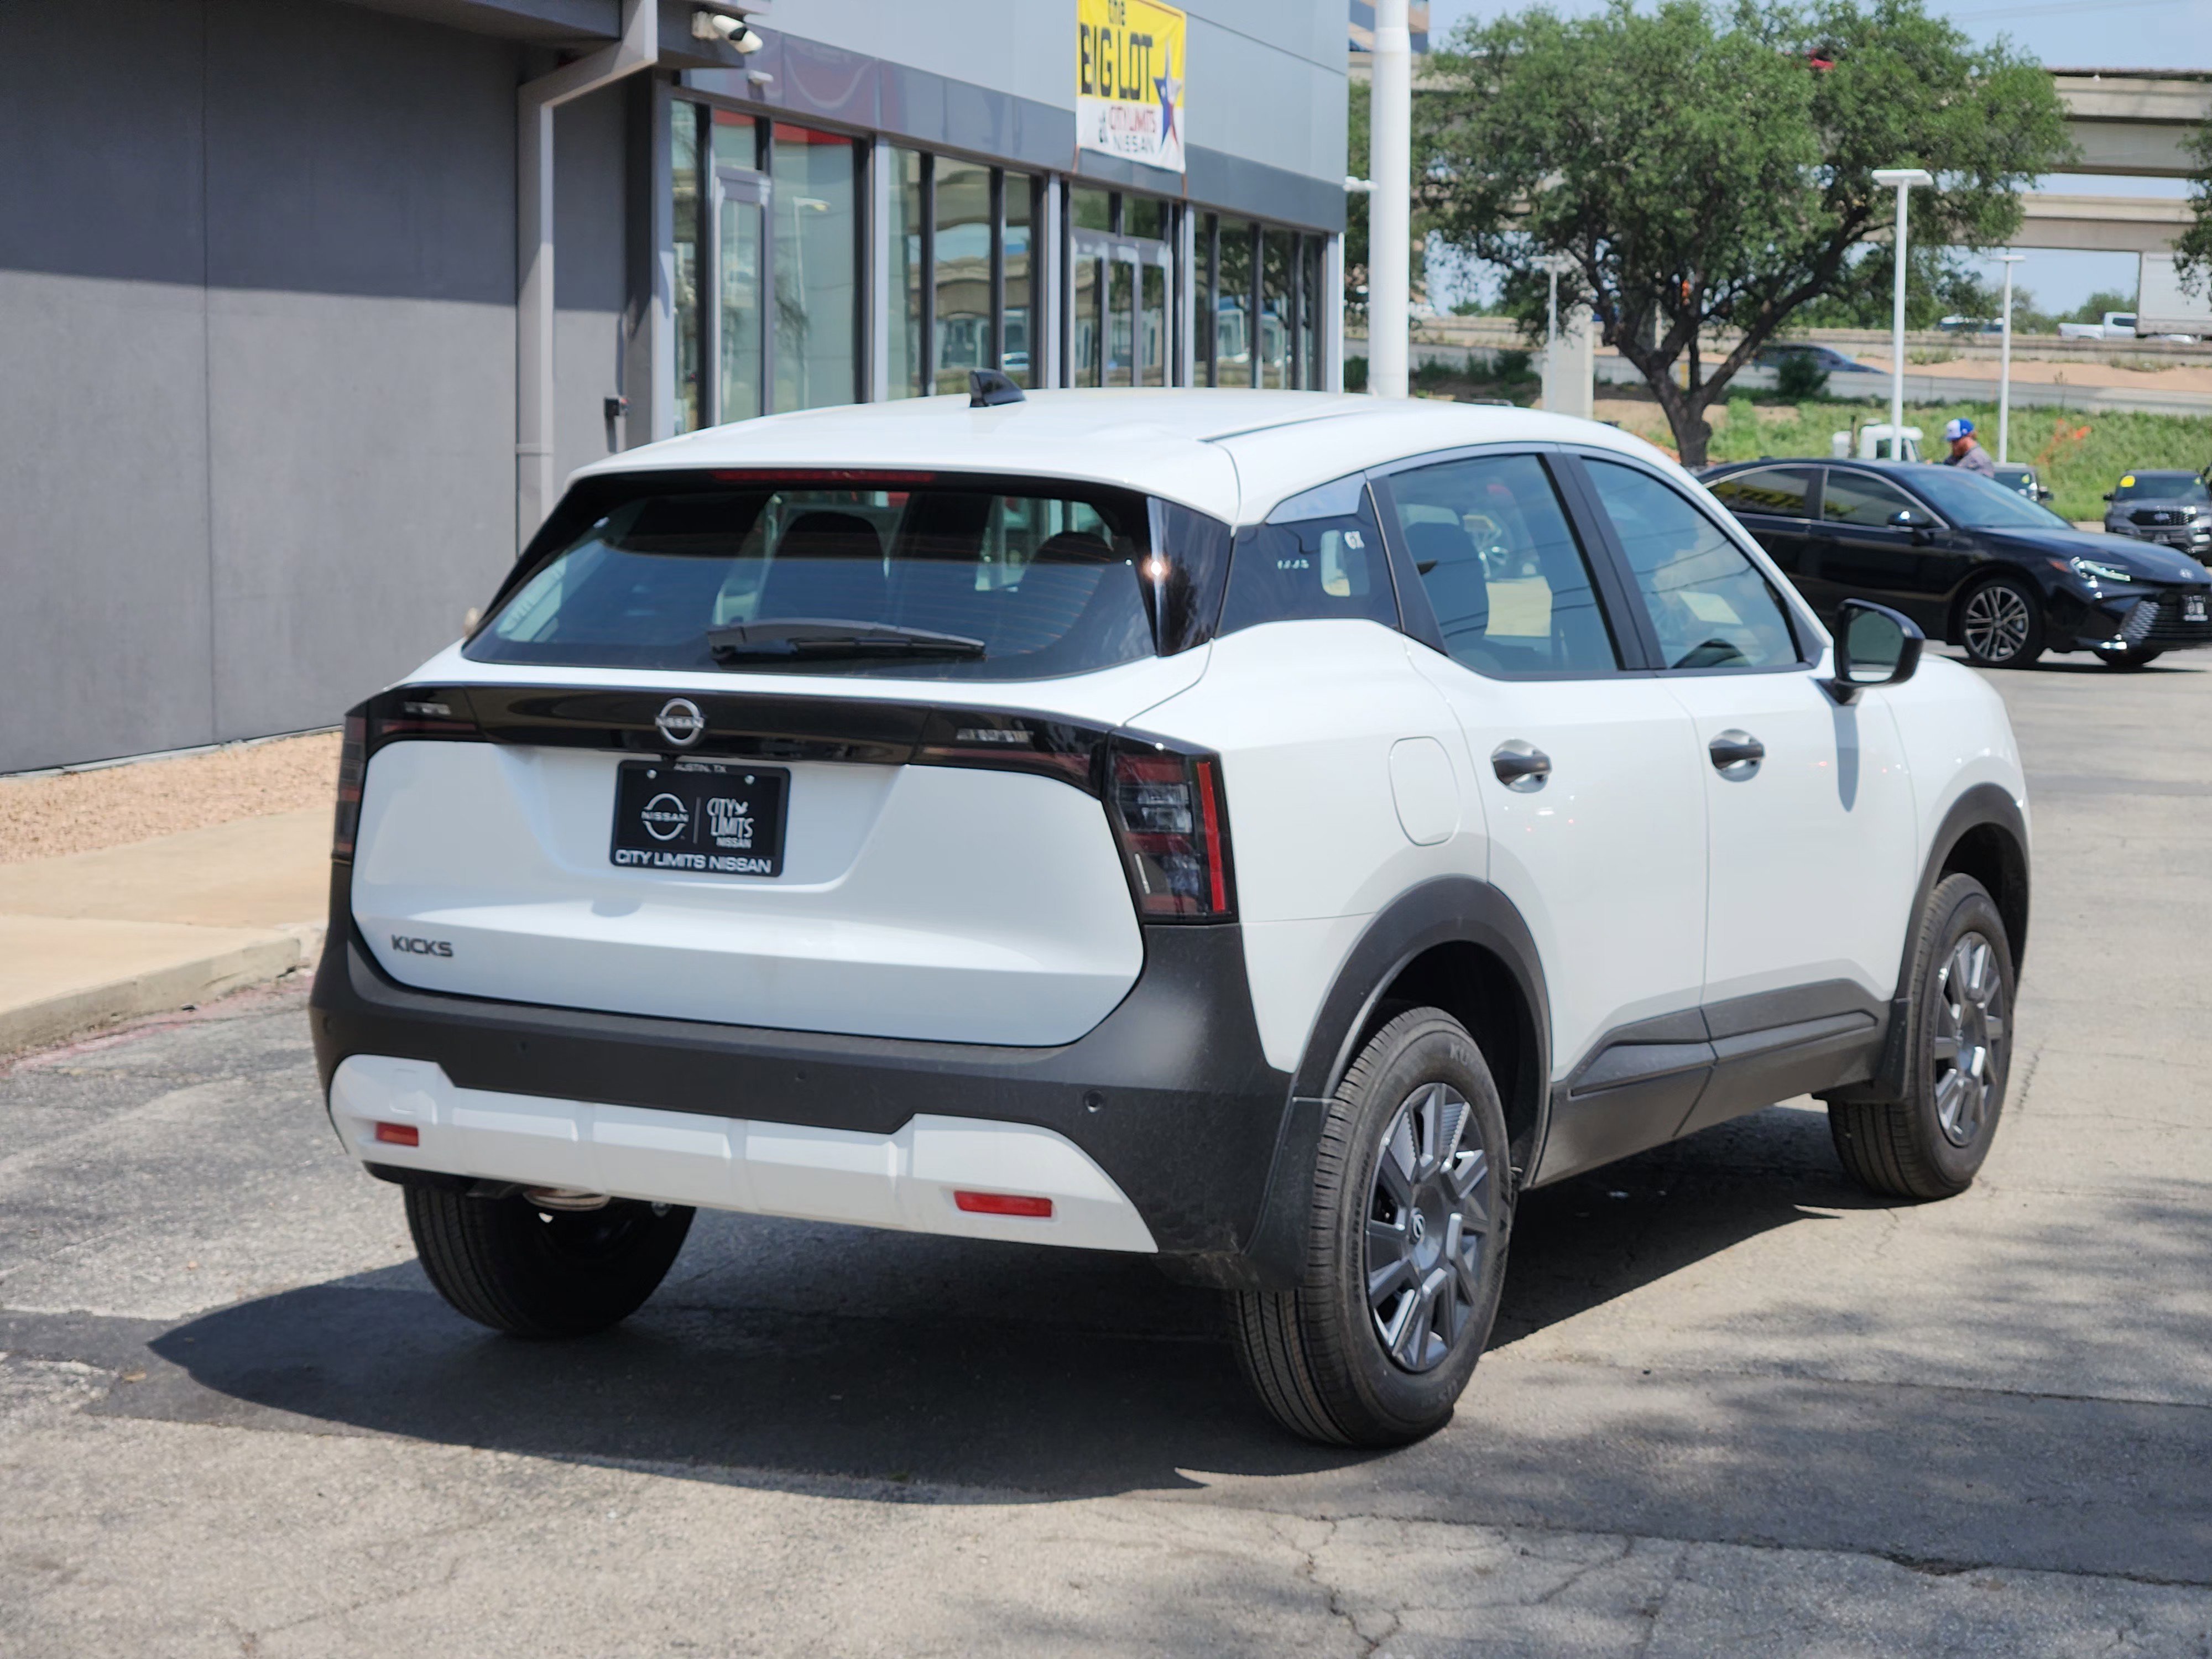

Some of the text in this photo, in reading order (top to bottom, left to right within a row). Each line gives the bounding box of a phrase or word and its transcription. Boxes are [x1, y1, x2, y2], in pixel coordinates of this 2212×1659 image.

[1081, 22, 1152, 102] BIG LOT
[1113, 134, 1155, 154] NISSAN
[655, 716, 704, 728] NISSAN
[641, 810, 690, 823] NISSAN
[707, 797, 737, 817] CITY
[711, 817, 754, 838] LIMITS
[716, 837, 752, 848] NISSAN
[615, 849, 772, 874] CITY LIMITS NISSAN
[391, 934, 453, 957] KICKS
